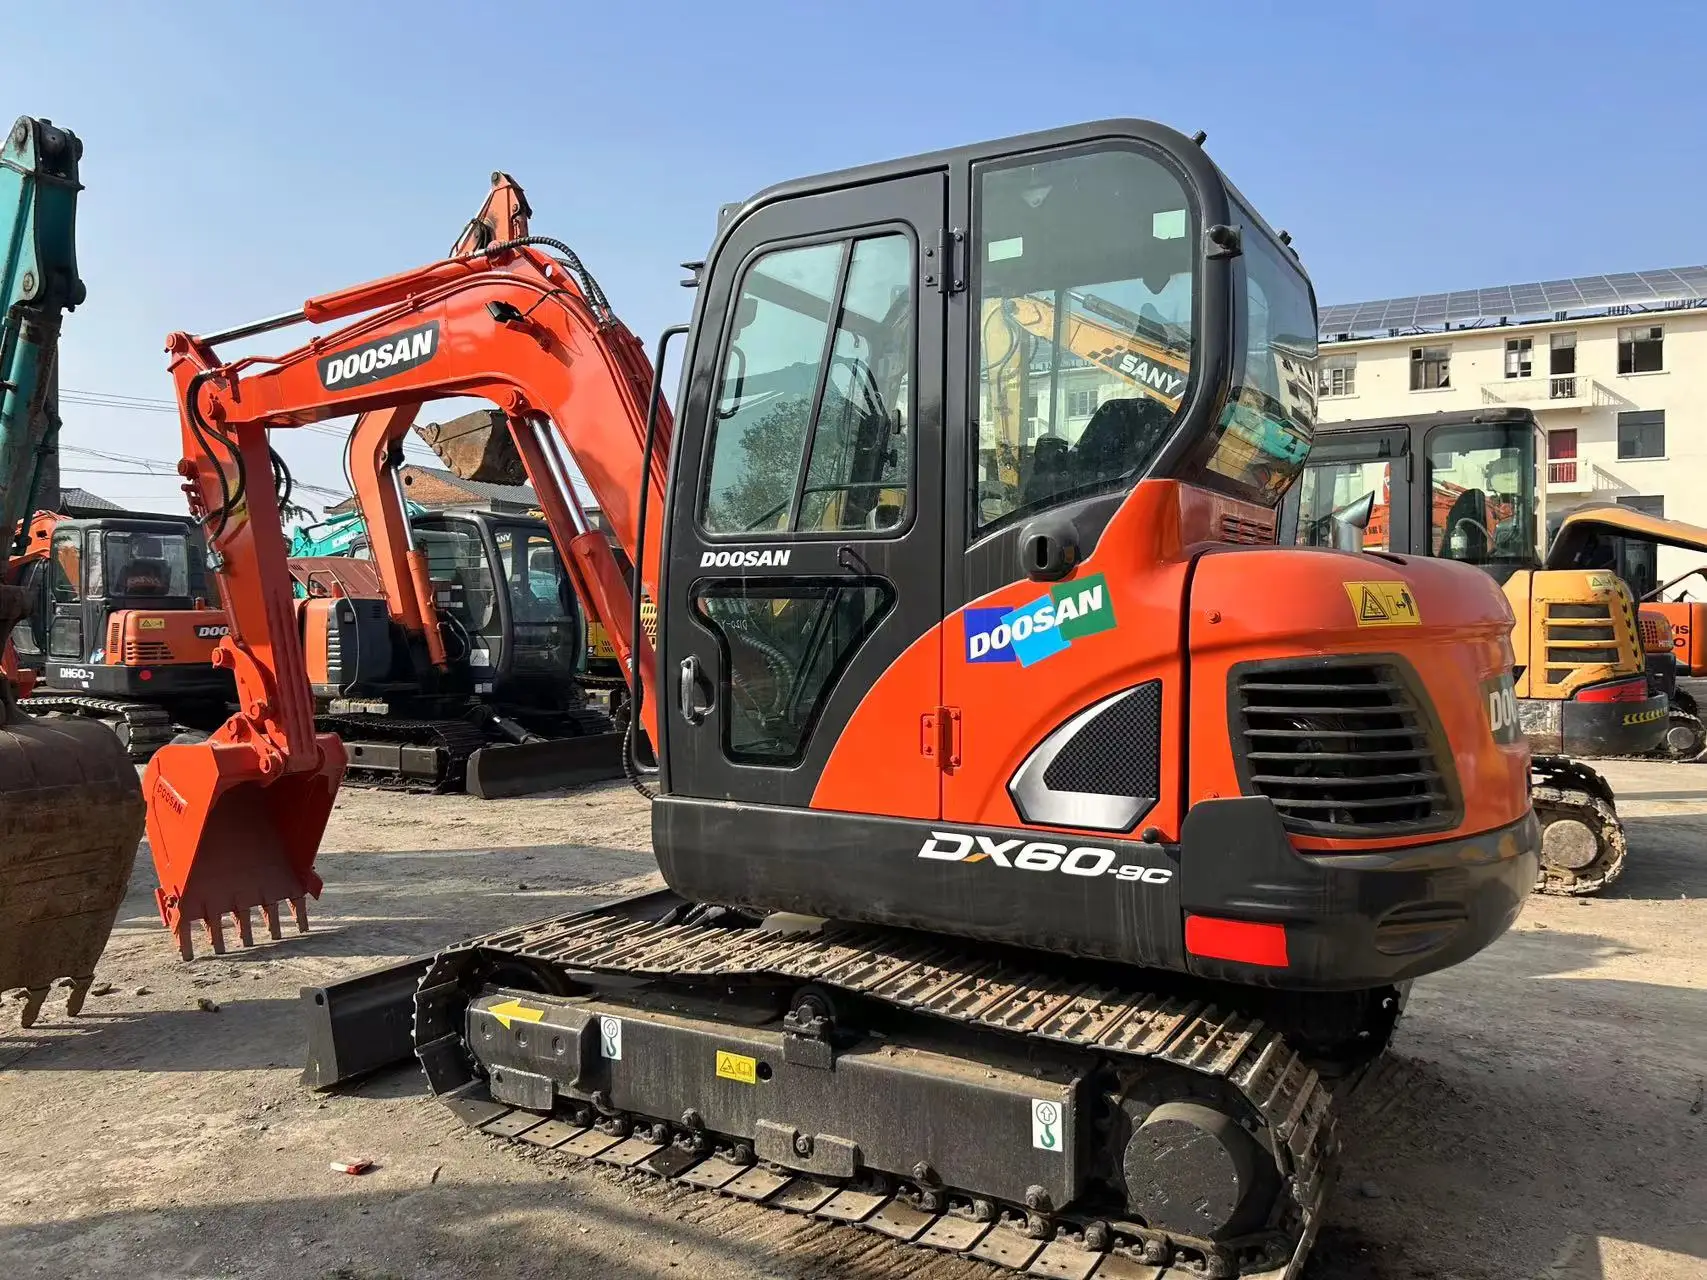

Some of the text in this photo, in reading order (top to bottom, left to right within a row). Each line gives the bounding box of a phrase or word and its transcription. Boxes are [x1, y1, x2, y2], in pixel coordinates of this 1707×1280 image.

[325, 329, 433, 386] DOOSAN
[1119, 354, 1182, 393] SANY
[700, 549, 792, 567] DOOSAN
[199, 626, 231, 637] DOO
[969, 584, 1103, 660] DOOSAN
[60, 667, 94, 680] DH60-7
[157, 783, 183, 815] DOOSAN
[917, 831, 1173, 884] DX60-9C
